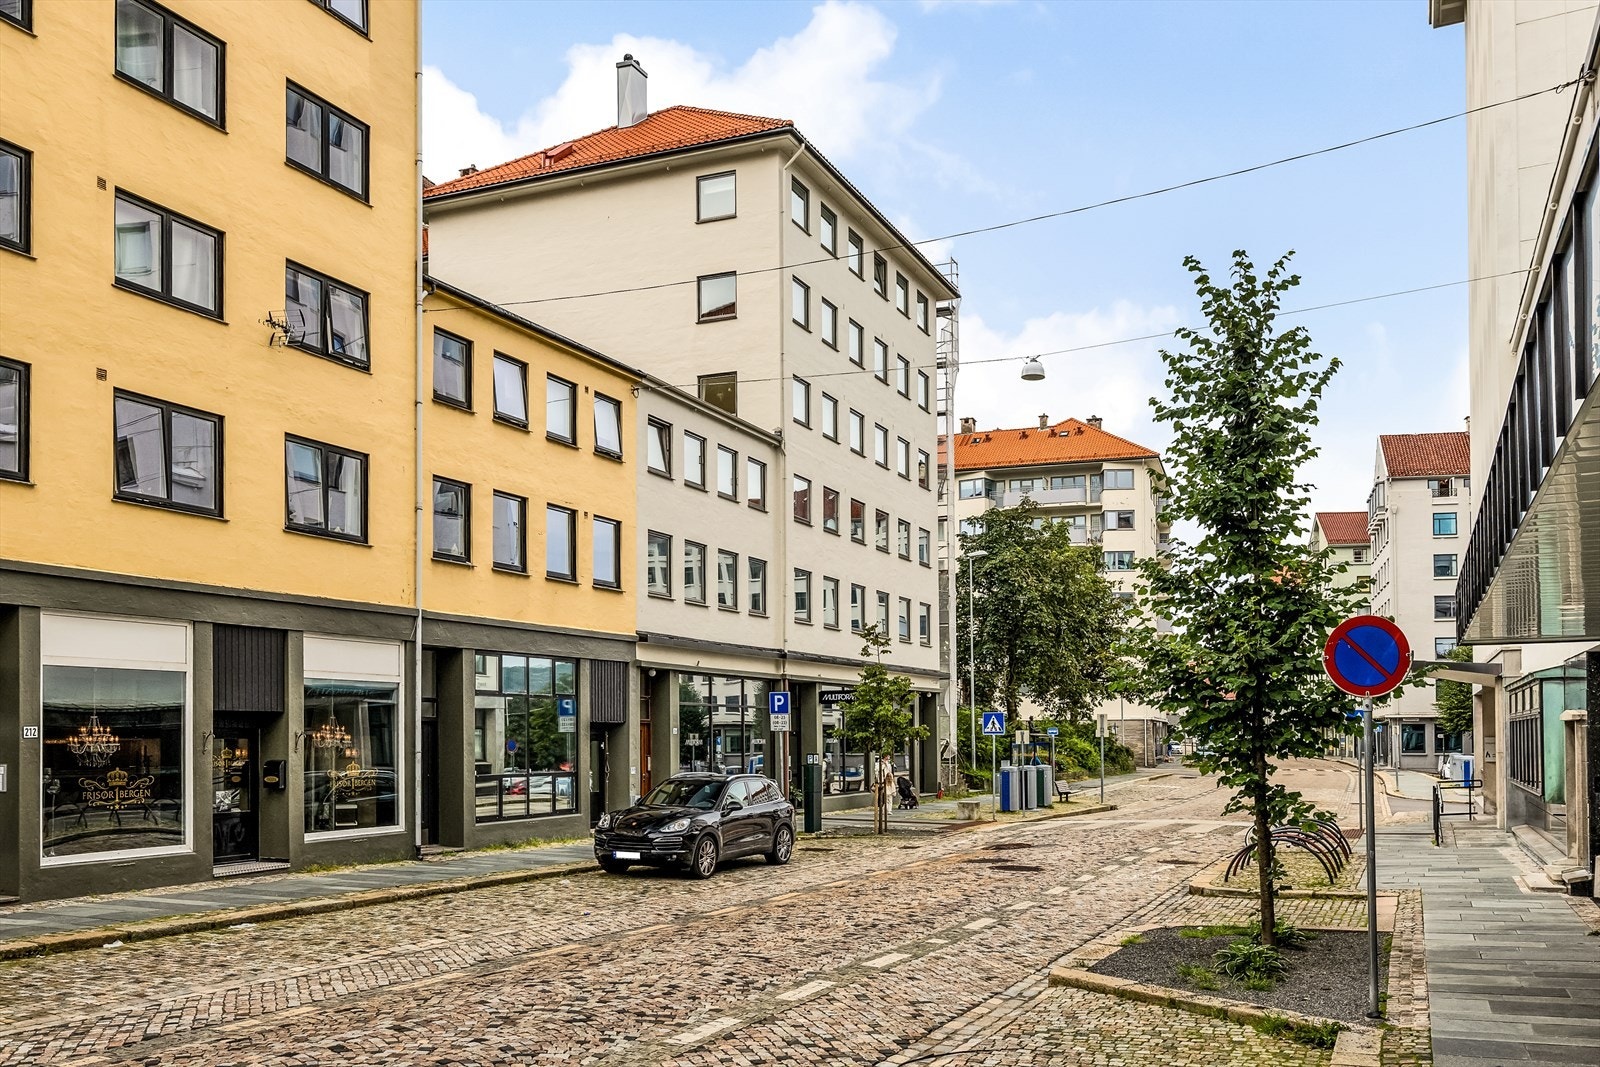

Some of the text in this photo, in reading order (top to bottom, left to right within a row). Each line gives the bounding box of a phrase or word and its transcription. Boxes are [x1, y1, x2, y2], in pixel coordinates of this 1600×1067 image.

[774, 695, 785, 712] P
[24, 727, 37, 737] 212
[119, 788, 151, 799] BERGEN
